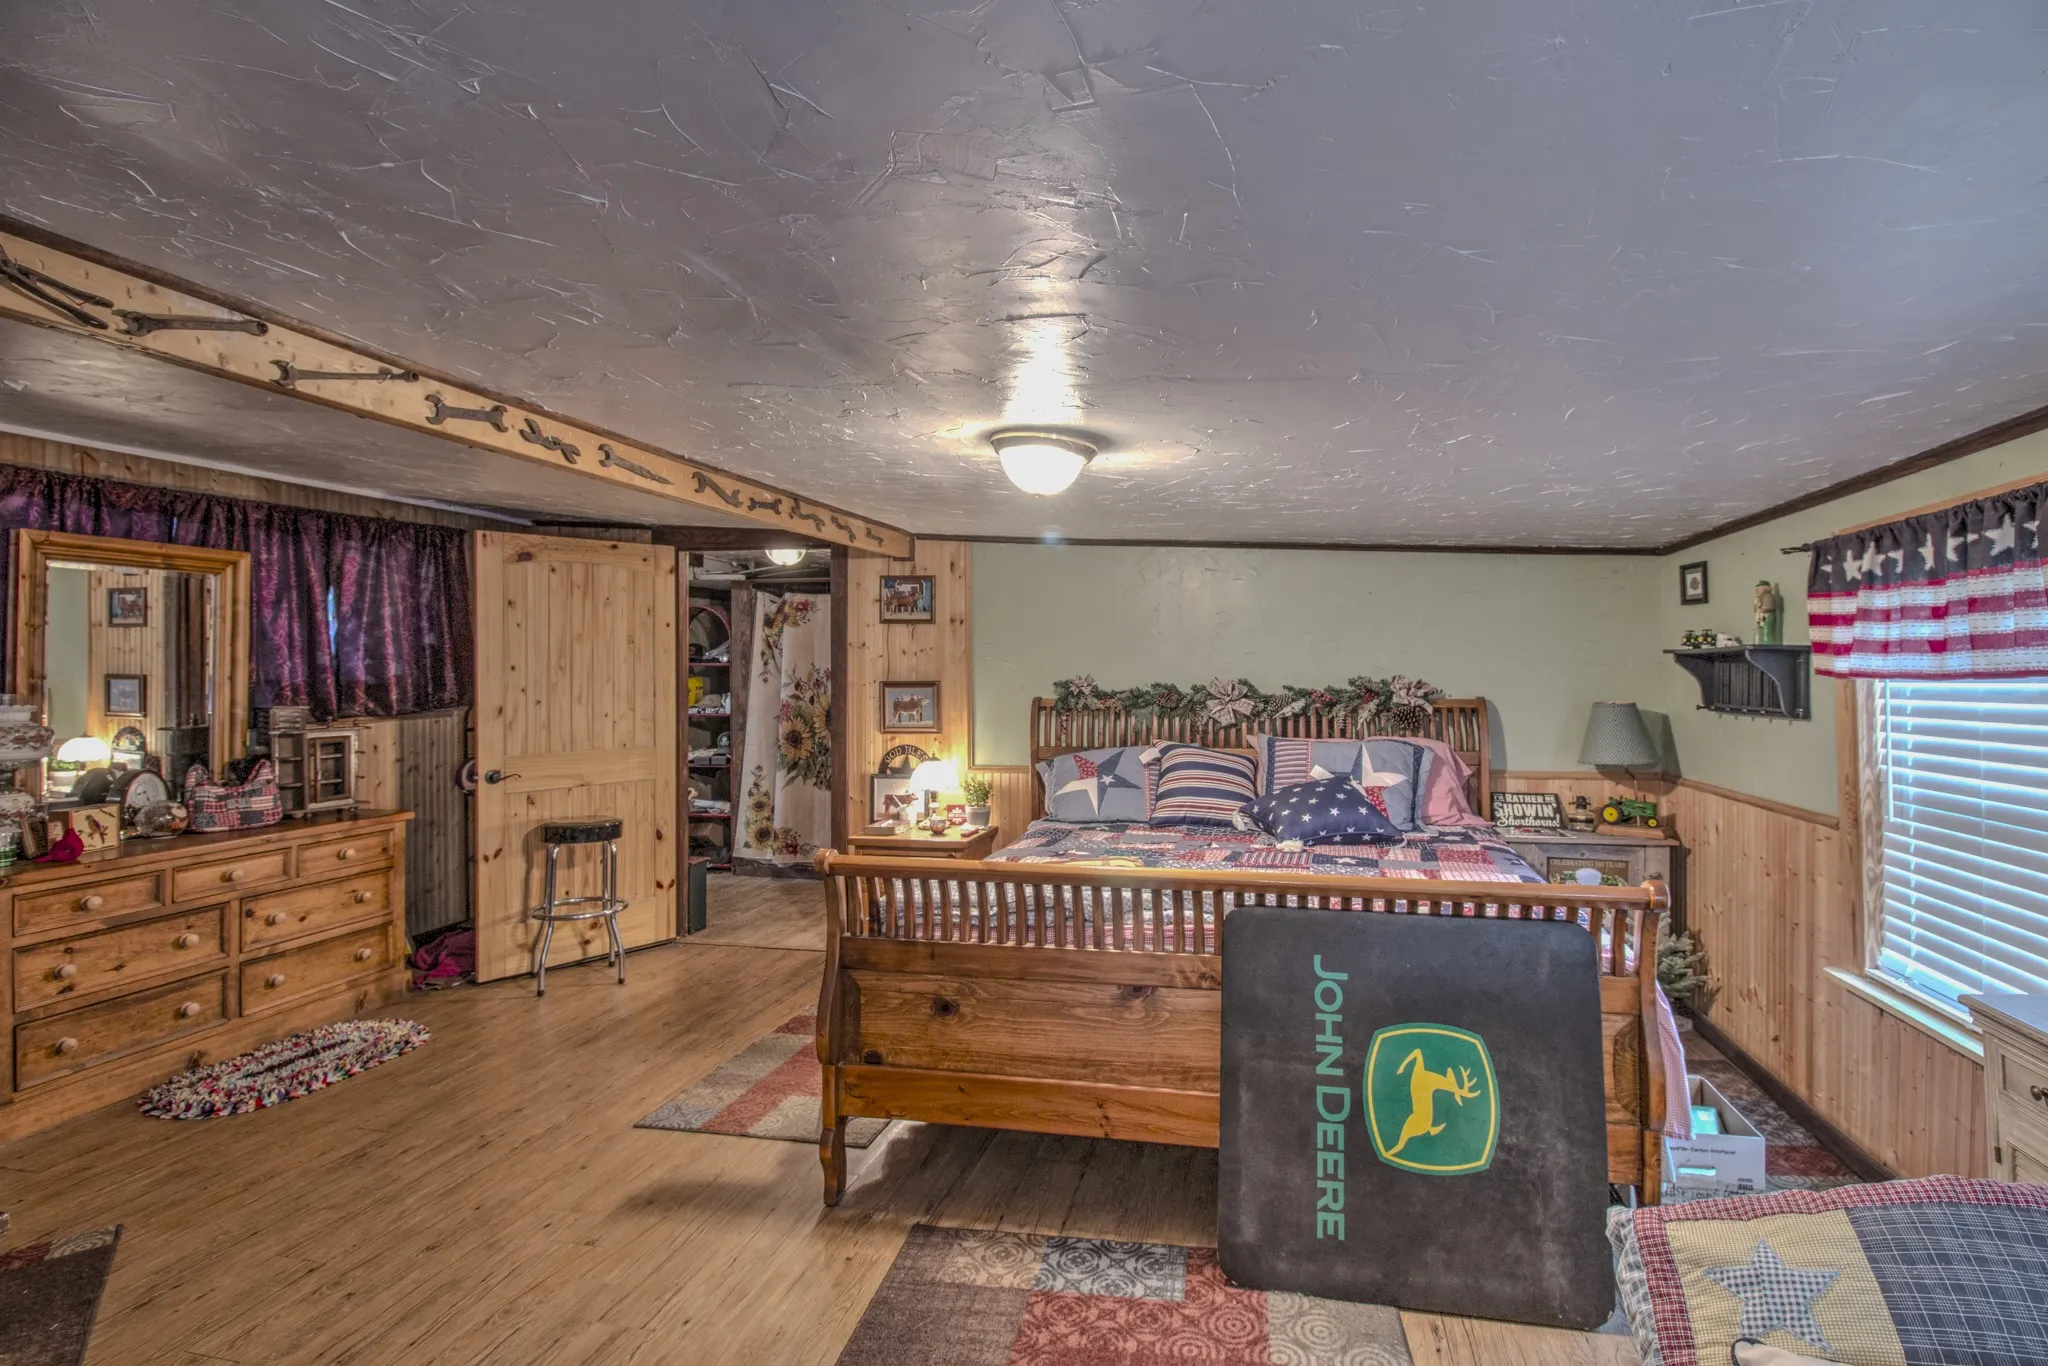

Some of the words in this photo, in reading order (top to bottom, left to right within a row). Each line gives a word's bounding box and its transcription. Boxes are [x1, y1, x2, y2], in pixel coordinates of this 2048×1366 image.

[884, 747, 902, 763] GOD
[905, 745, 928, 761] BLES
[1505, 794, 1543, 803] RATHER
[1493, 802, 1557, 817] SHOWIN'
[1497, 814, 1560, 827] Shorthorns!
[1549, 858, 1594, 868] CELEBRATING
[1605, 861, 1627, 869] YEARS
[1313, 954, 1349, 1076] JOHN
[1316, 1084, 1351, 1241] DEERE
